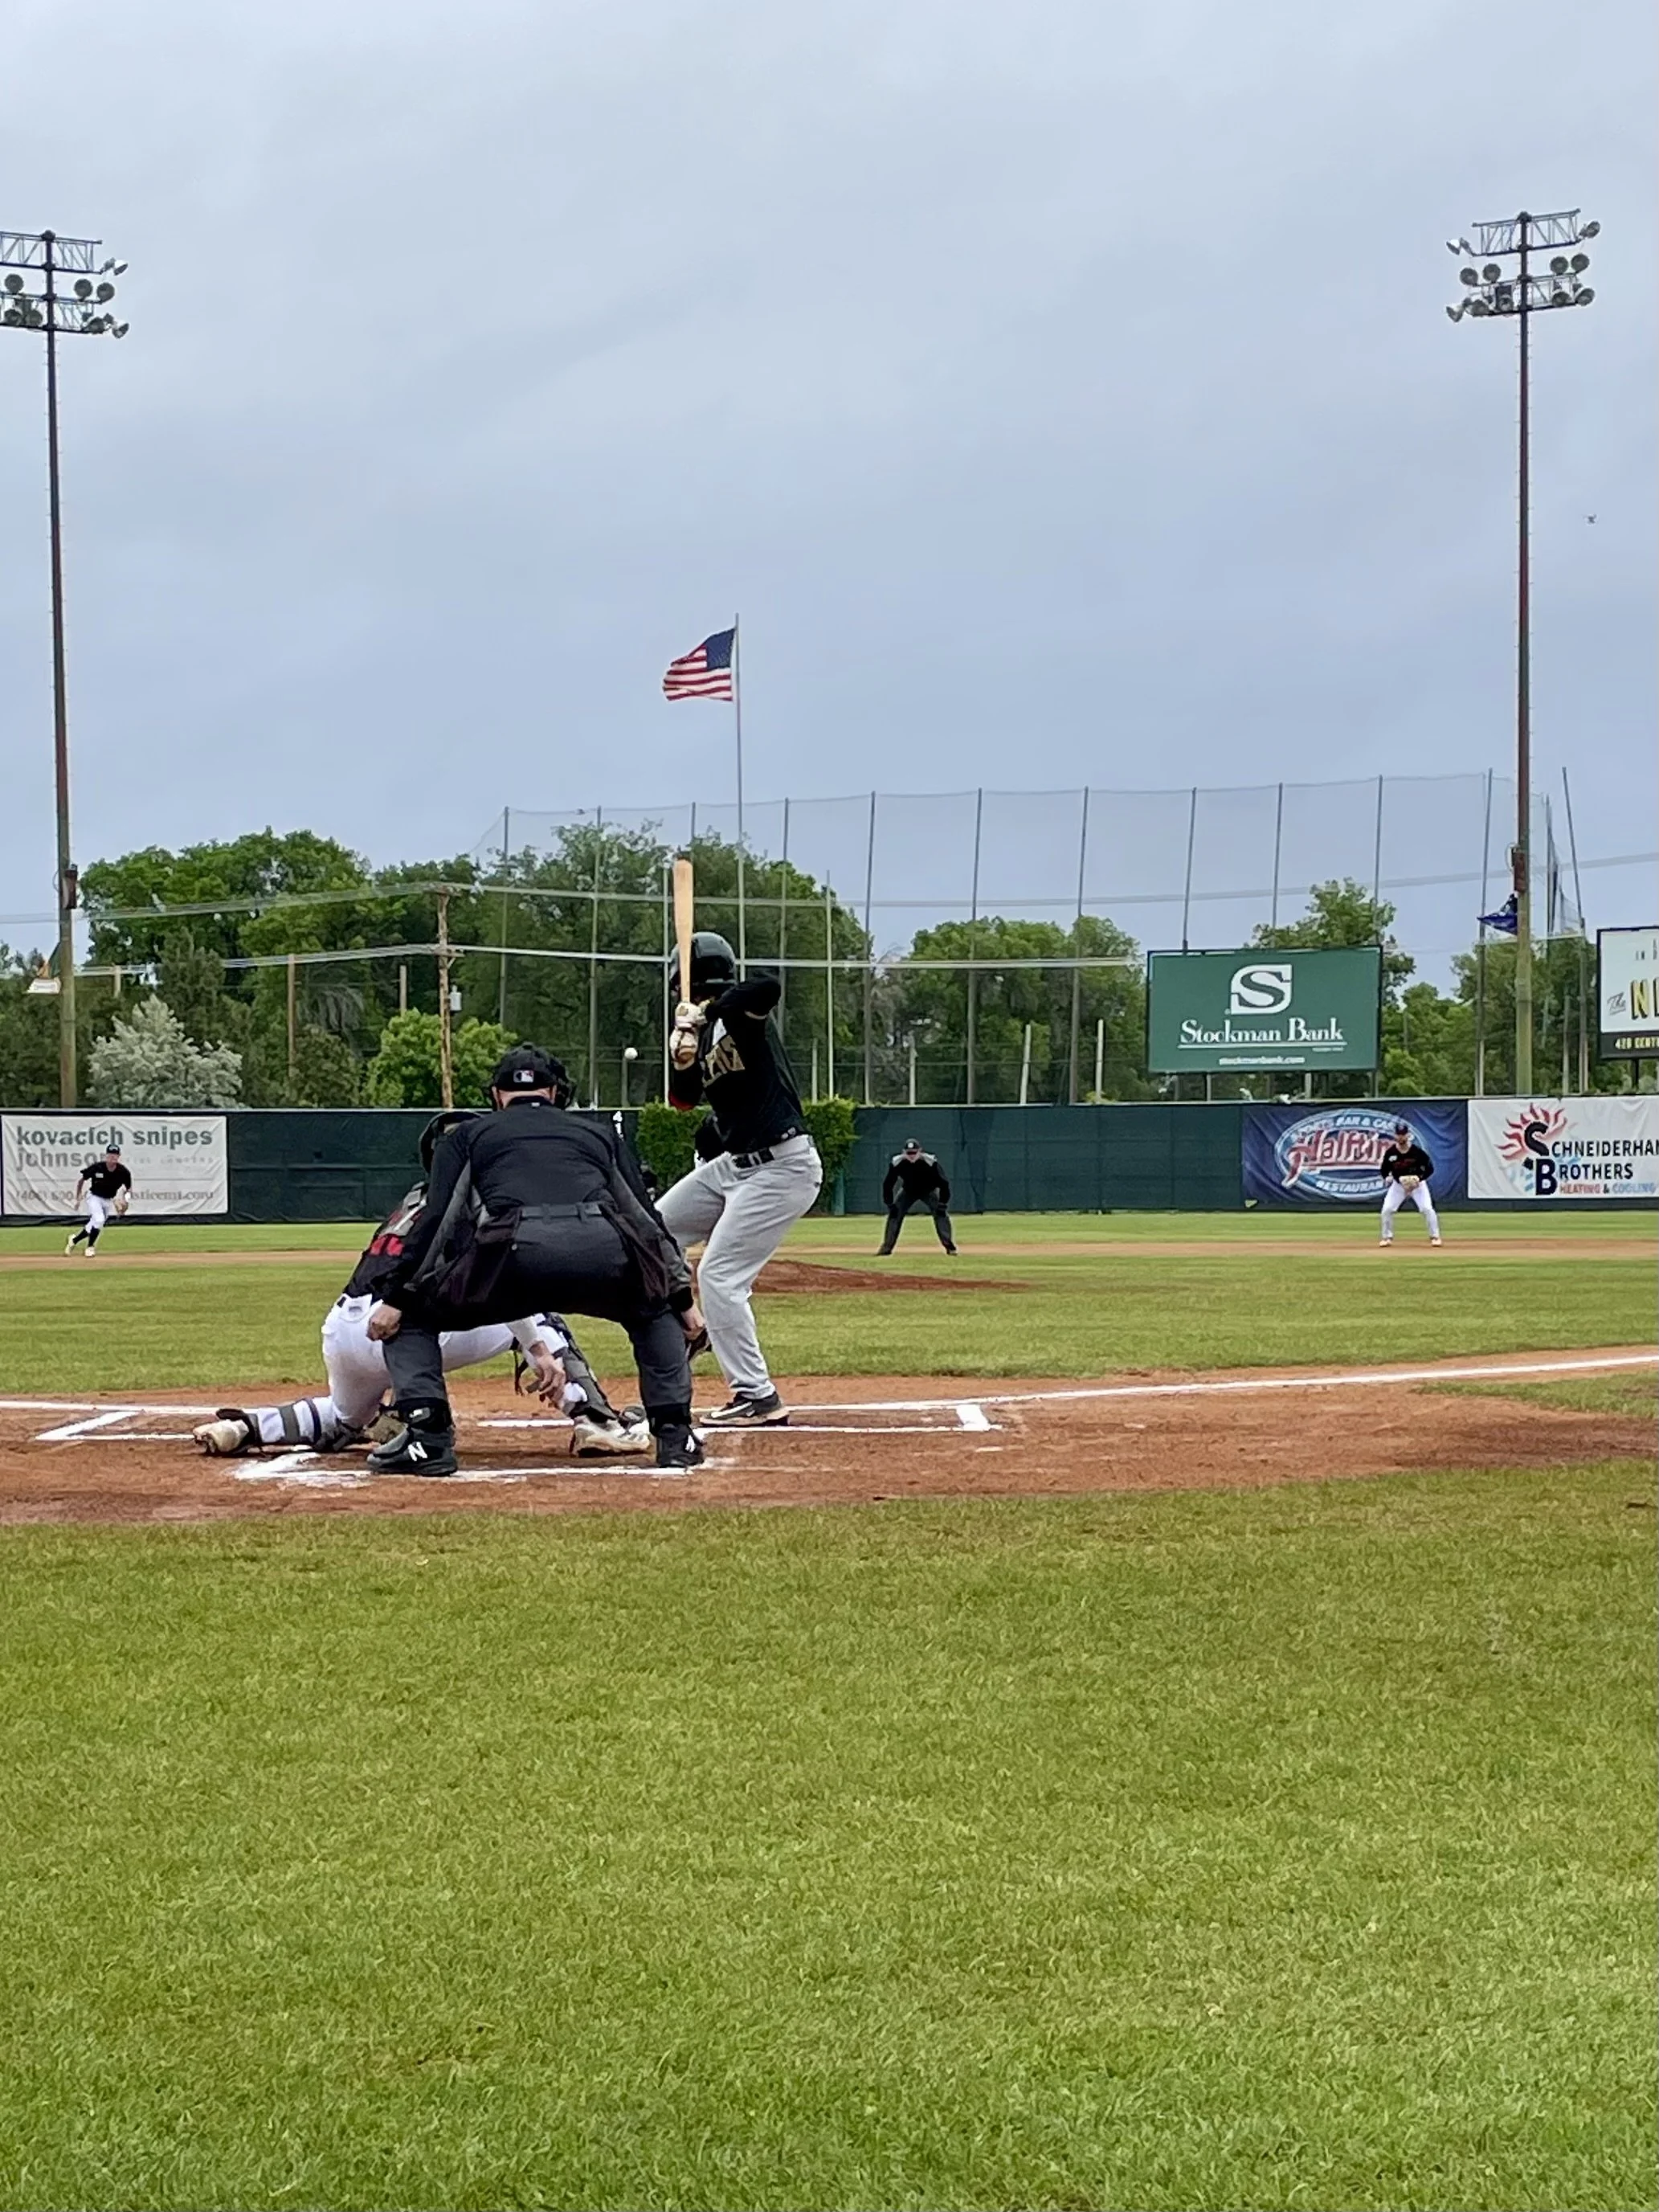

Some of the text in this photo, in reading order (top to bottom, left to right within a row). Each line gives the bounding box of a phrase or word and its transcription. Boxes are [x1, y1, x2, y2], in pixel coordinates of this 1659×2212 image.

[1180, 1016, 1344, 1043] Stockman Bank
[1335, 1118, 1360, 1126] BAR
[16, 1126, 213, 1150] kovacich snipes
[1315, 1180, 1384, 1192] RESTAURAN
[1560, 1181, 1655, 1194] HEATING & COOLING
